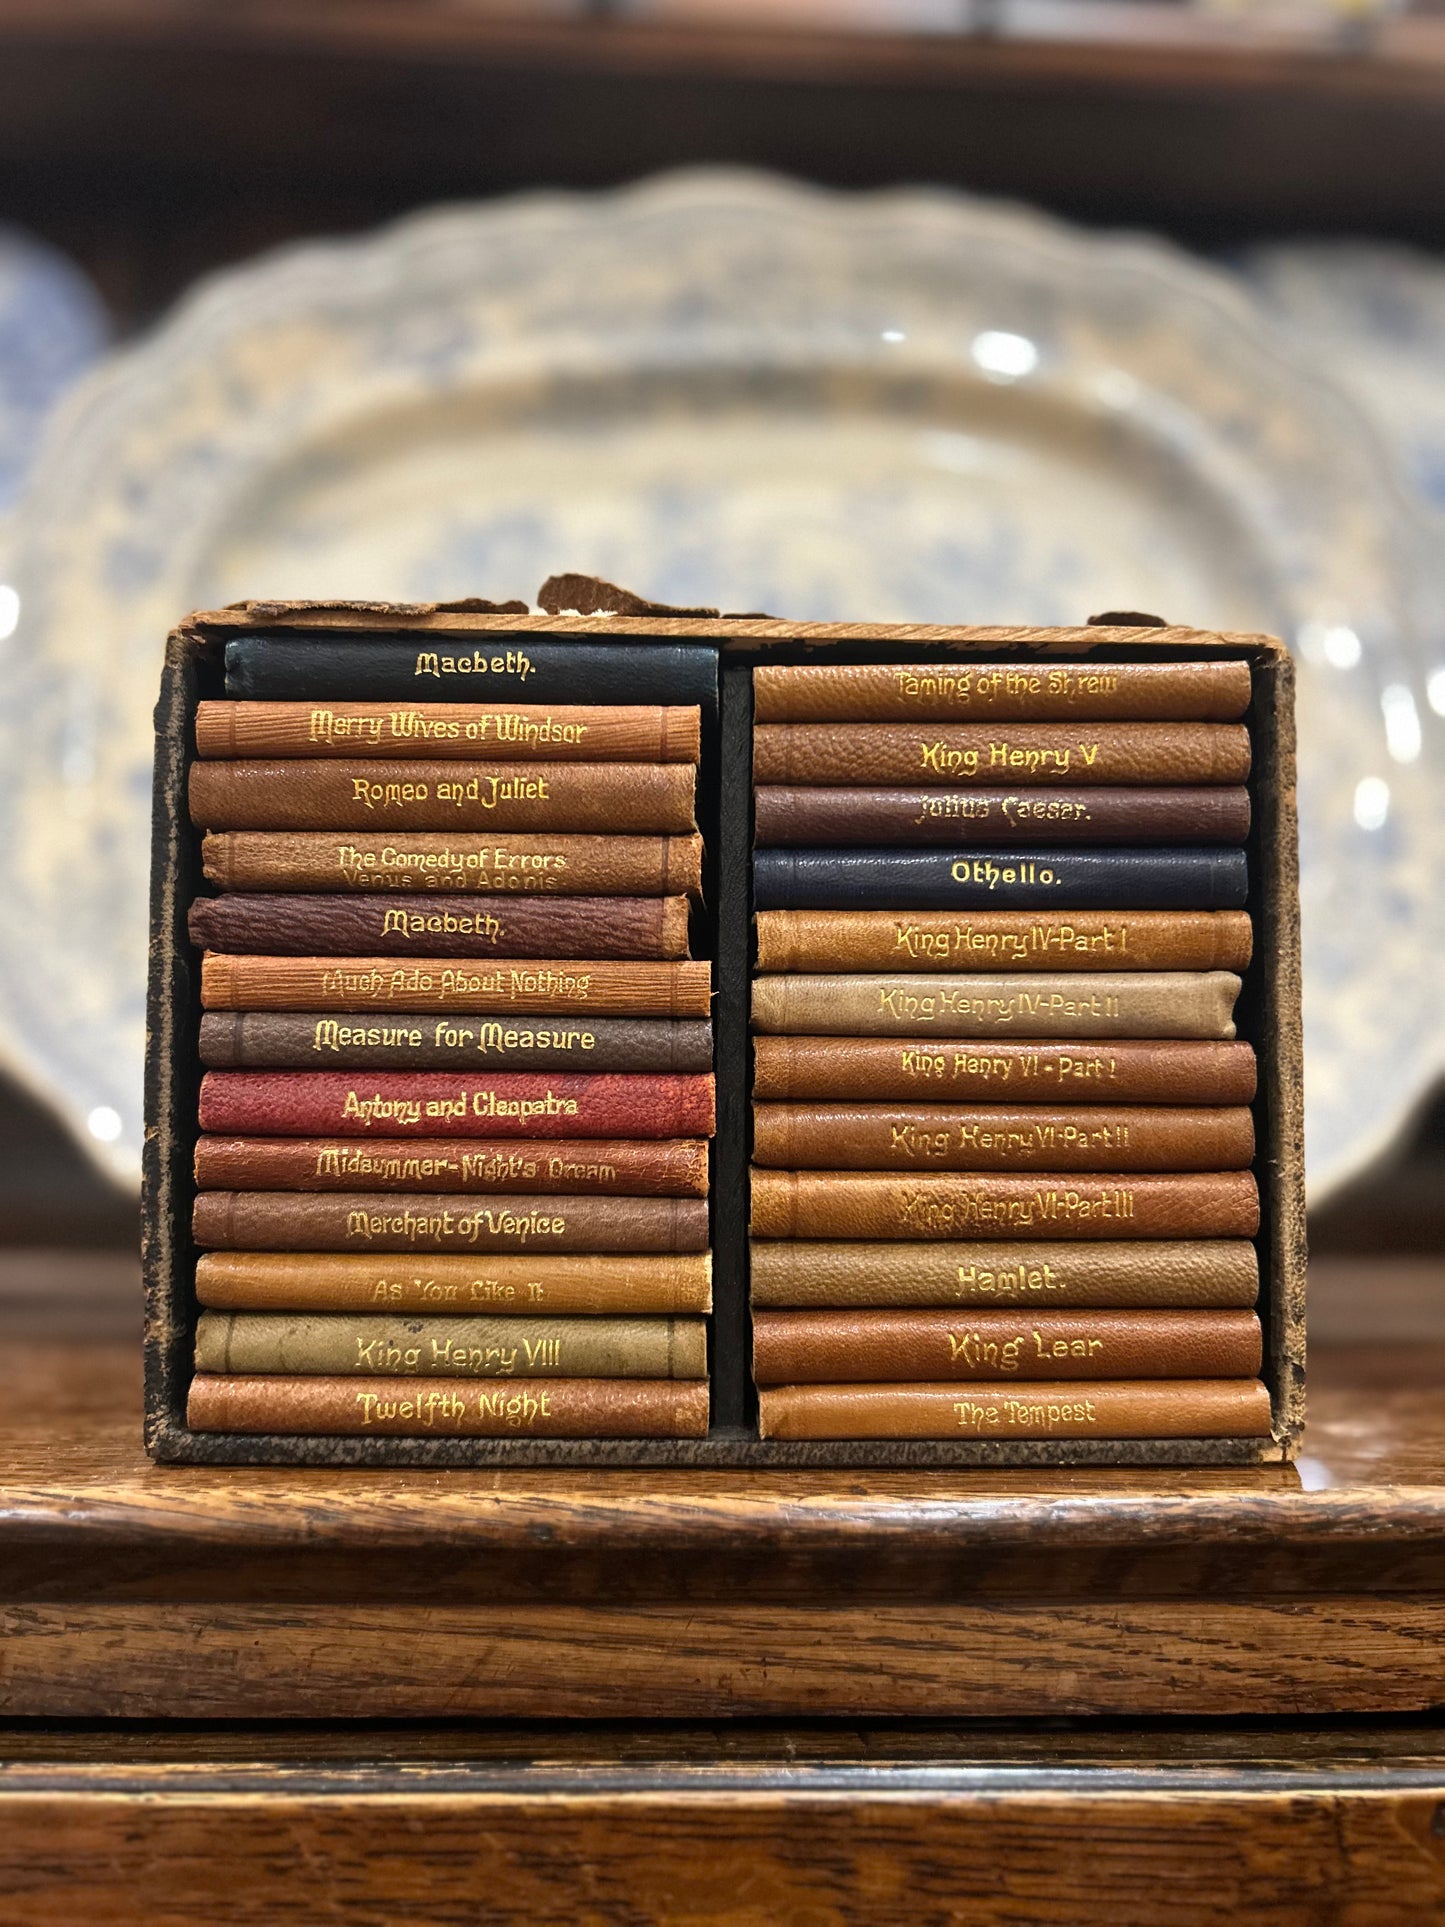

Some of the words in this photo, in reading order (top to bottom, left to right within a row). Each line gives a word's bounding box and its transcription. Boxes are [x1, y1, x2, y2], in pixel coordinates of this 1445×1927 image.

[415, 652, 536, 680] Macbeth.
[895, 673, 971, 703] Taming
[977, 673, 1004, 701] of
[1003, 673, 1041, 696] the
[310, 710, 384, 745] Merry
[391, 713, 459, 740] Wives
[466, 716, 492, 741] of
[495, 715, 587, 749] Windsor
[921, 742, 979, 776] King
[988, 744, 1070, 776] Henry
[1080, 744, 1099, 765] V
[352, 778, 428, 809] Romeo
[437, 781, 479, 807] and
[479, 777, 550, 809] Juliet
[1002, 798, 1091, 827] Caesar.
[338, 847, 376, 869] The
[381, 849, 465, 876] Comedy
[467, 850, 492, 874] of
[951, 860, 1062, 890] Othello.
[425, 870, 469, 889] and
[380, 909, 506, 944] Macbeth.
[896, 924, 950, 958] King
[954, 925, 1030, 959] Henry
[322, 969, 385, 999] Much
[389, 970, 433, 999] Ado
[438, 970, 505, 999] About
[510, 972, 591, 1000] Nothing
[877, 989, 936, 1020] King
[940, 991, 1015, 1022] Henry
[313, 1020, 422, 1051] Measure
[435, 1021, 472, 1048] for
[478, 1023, 595, 1052] Measure
[901, 1051, 946, 1078] King
[954, 1054, 1012, 1078] Henry
[1058, 1058, 1103, 1080] Part
[341, 1090, 421, 1124] Antony
[425, 1094, 466, 1121] and
[472, 1091, 579, 1123] Cleopatra
[890, 1125, 949, 1156] King
[960, 1125, 1032, 1156] Henry
[549, 1159, 617, 1183] Dream
[901, 1190, 955, 1224] King
[959, 1191, 1035, 1224] Henry
[346, 1211, 453, 1243] Merchant
[458, 1214, 485, 1243] of
[485, 1212, 565, 1242] Venice
[372, 1281, 403, 1302] As
[470, 1281, 515, 1303] Like
[957, 1266, 1066, 1296] Hamlet.
[355, 1338, 422, 1372] King
[430, 1338, 517, 1375] Henry
[521, 1338, 560, 1368] VIII
[948, 1332, 1025, 1370] King
[1034, 1332, 1103, 1359] Lear
[357, 1392, 466, 1426] Twelfth
[479, 1394, 552, 1427] Night
[953, 1402, 999, 1431] The
[1002, 1400, 1096, 1429] Tempest
